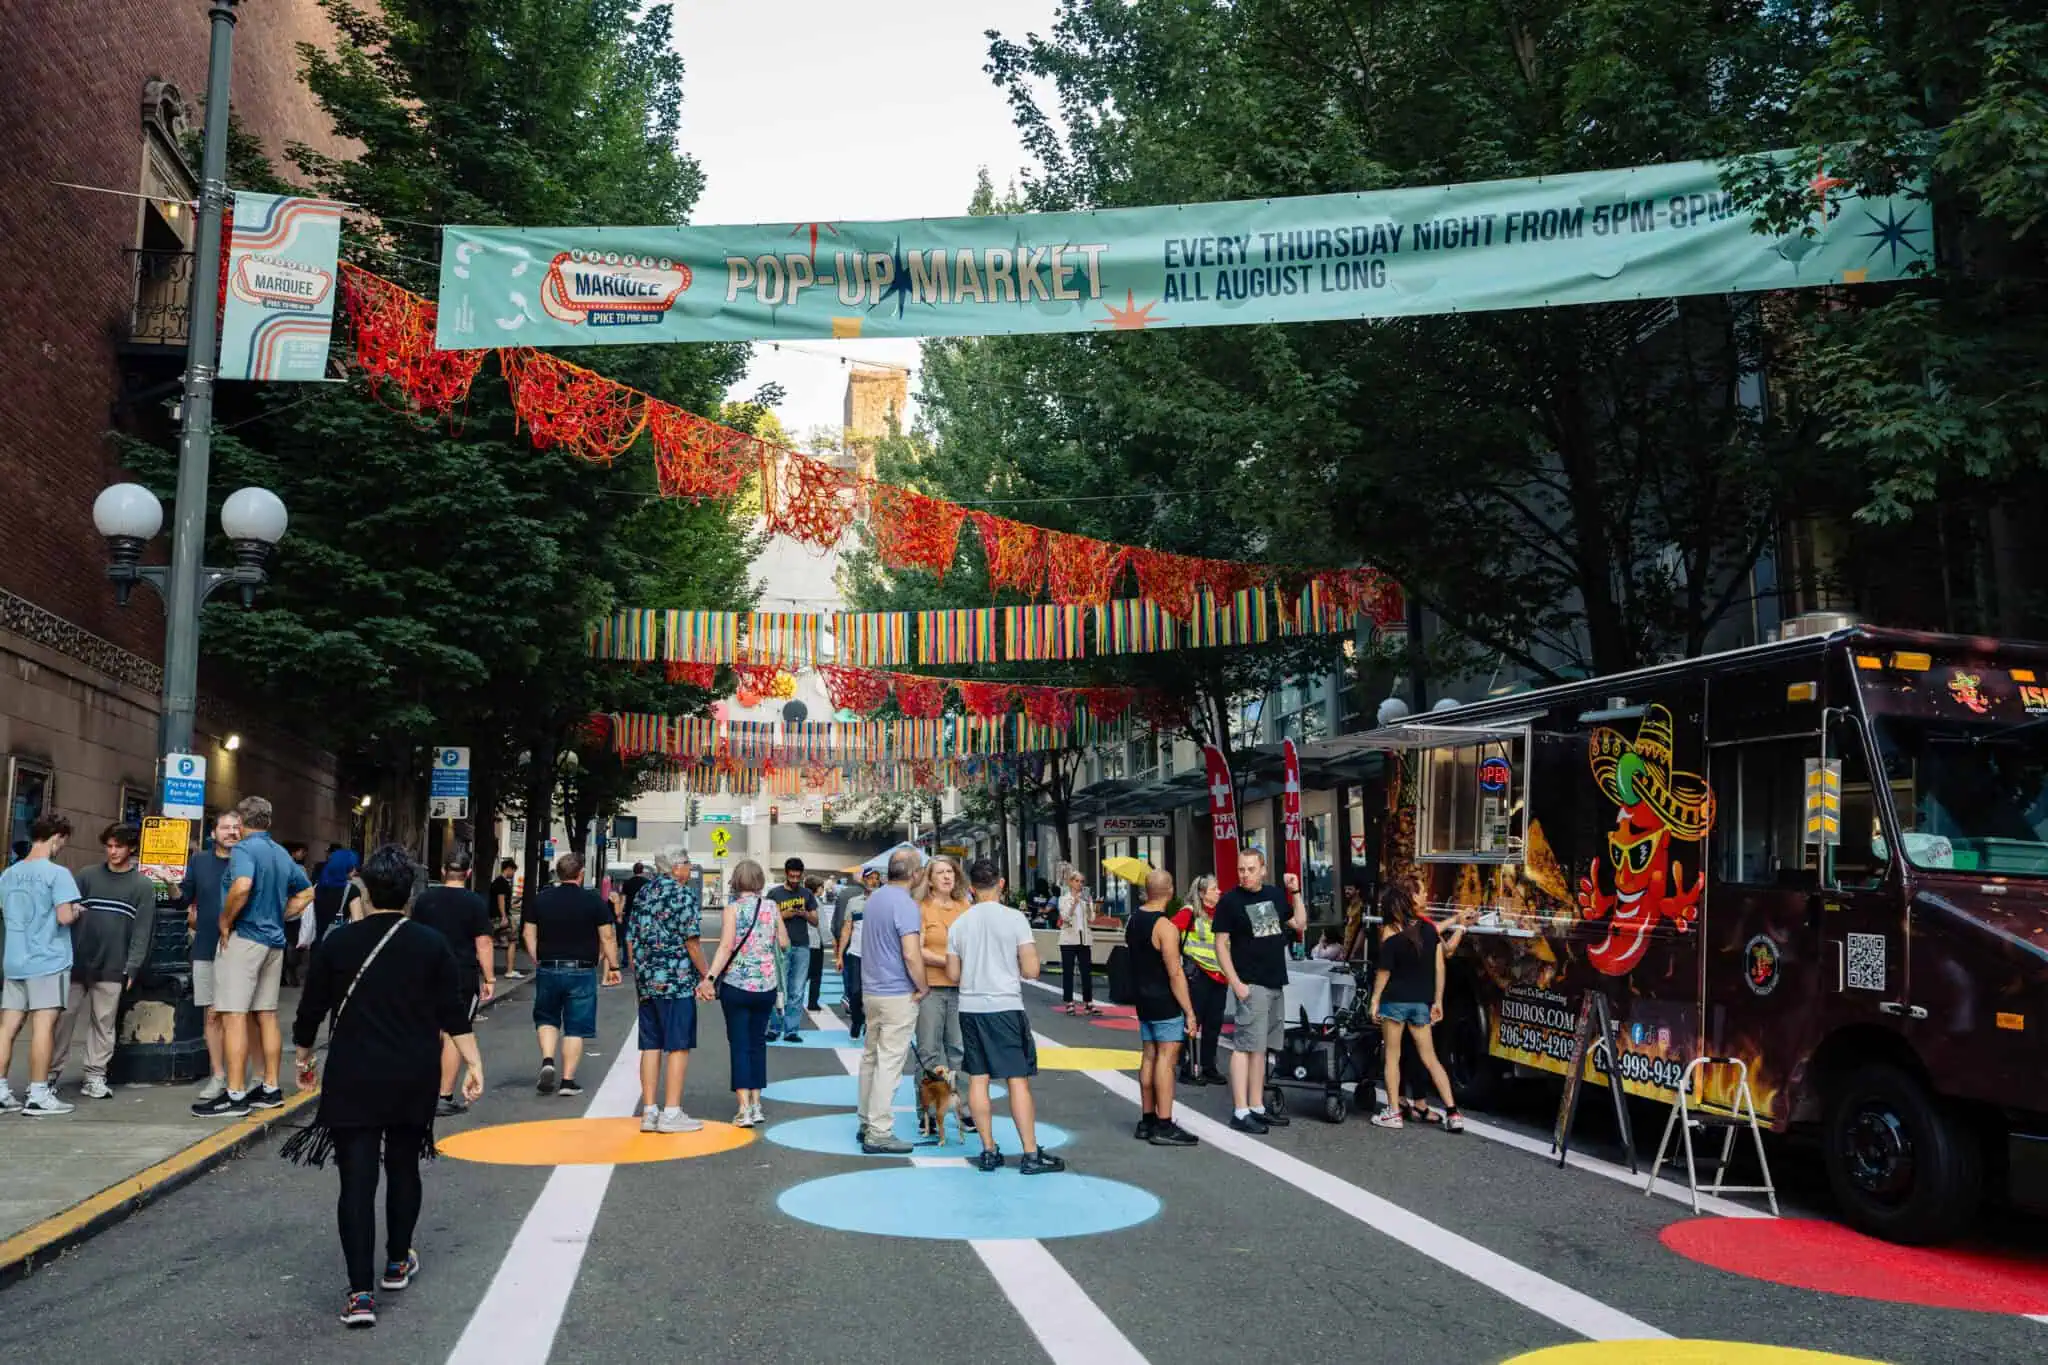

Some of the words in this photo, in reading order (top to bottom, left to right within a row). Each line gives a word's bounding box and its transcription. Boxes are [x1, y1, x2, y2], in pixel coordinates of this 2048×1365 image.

[1164, 234, 1248, 268] EVERY
[1258, 223, 1404, 263] THURSDAY
[1412, 213, 1497, 251] NIGHT
[1504, 206, 1585, 244] FROM
[1592, 192, 1733, 236] 5PM-8PM
[256, 275, 313, 295] MARQUEE
[576, 272, 662, 297] MARQUEE
[724, 252, 896, 305] POP-UP
[905, 244, 1109, 304] MARKET
[1163, 272, 1208, 304] ALL
[1215, 263, 1313, 301] AUGUST
[1320, 259, 1387, 292] LONG
[593, 311, 615, 324] PIKE
[1502, 999, 1575, 1031] ISIDROS.COM
